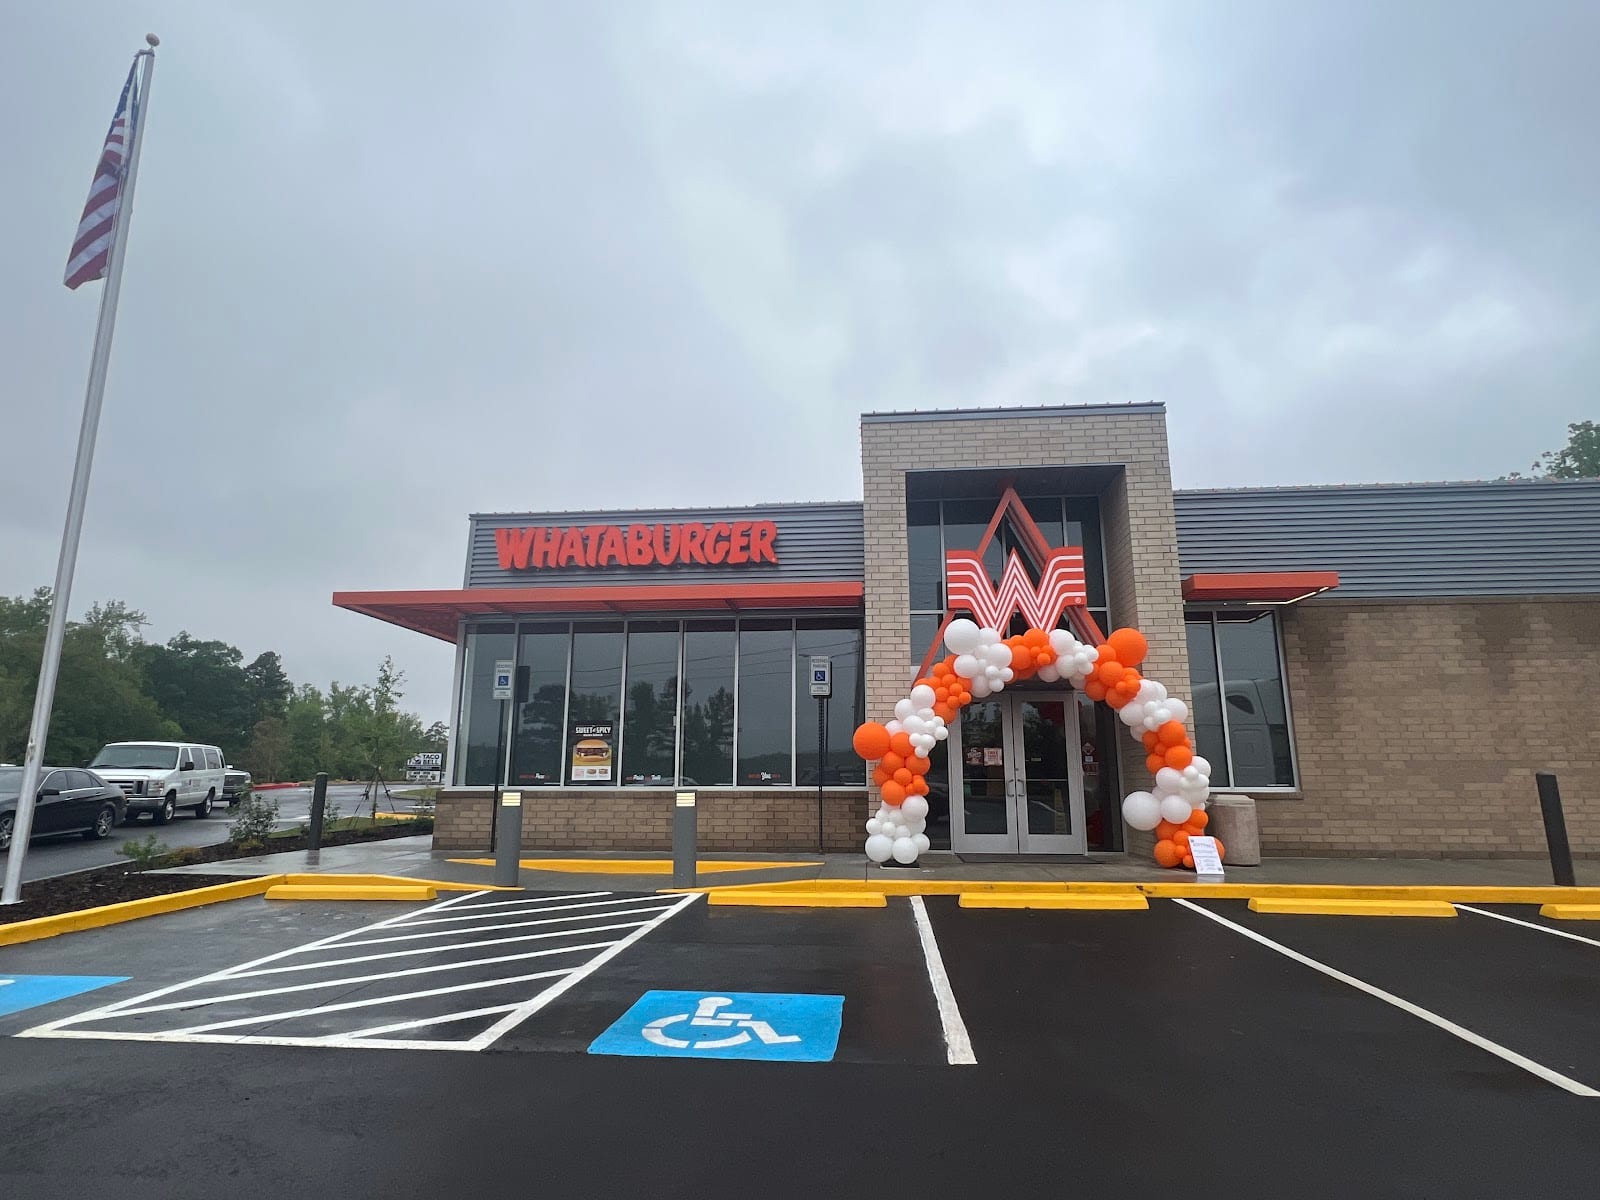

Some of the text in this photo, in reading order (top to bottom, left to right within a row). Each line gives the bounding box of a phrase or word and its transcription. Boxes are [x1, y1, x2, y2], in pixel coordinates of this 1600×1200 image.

[494, 520, 778, 570] WHATABURGER
[575, 726, 593, 734] SWEET
[596, 726, 611, 734] SPICY
